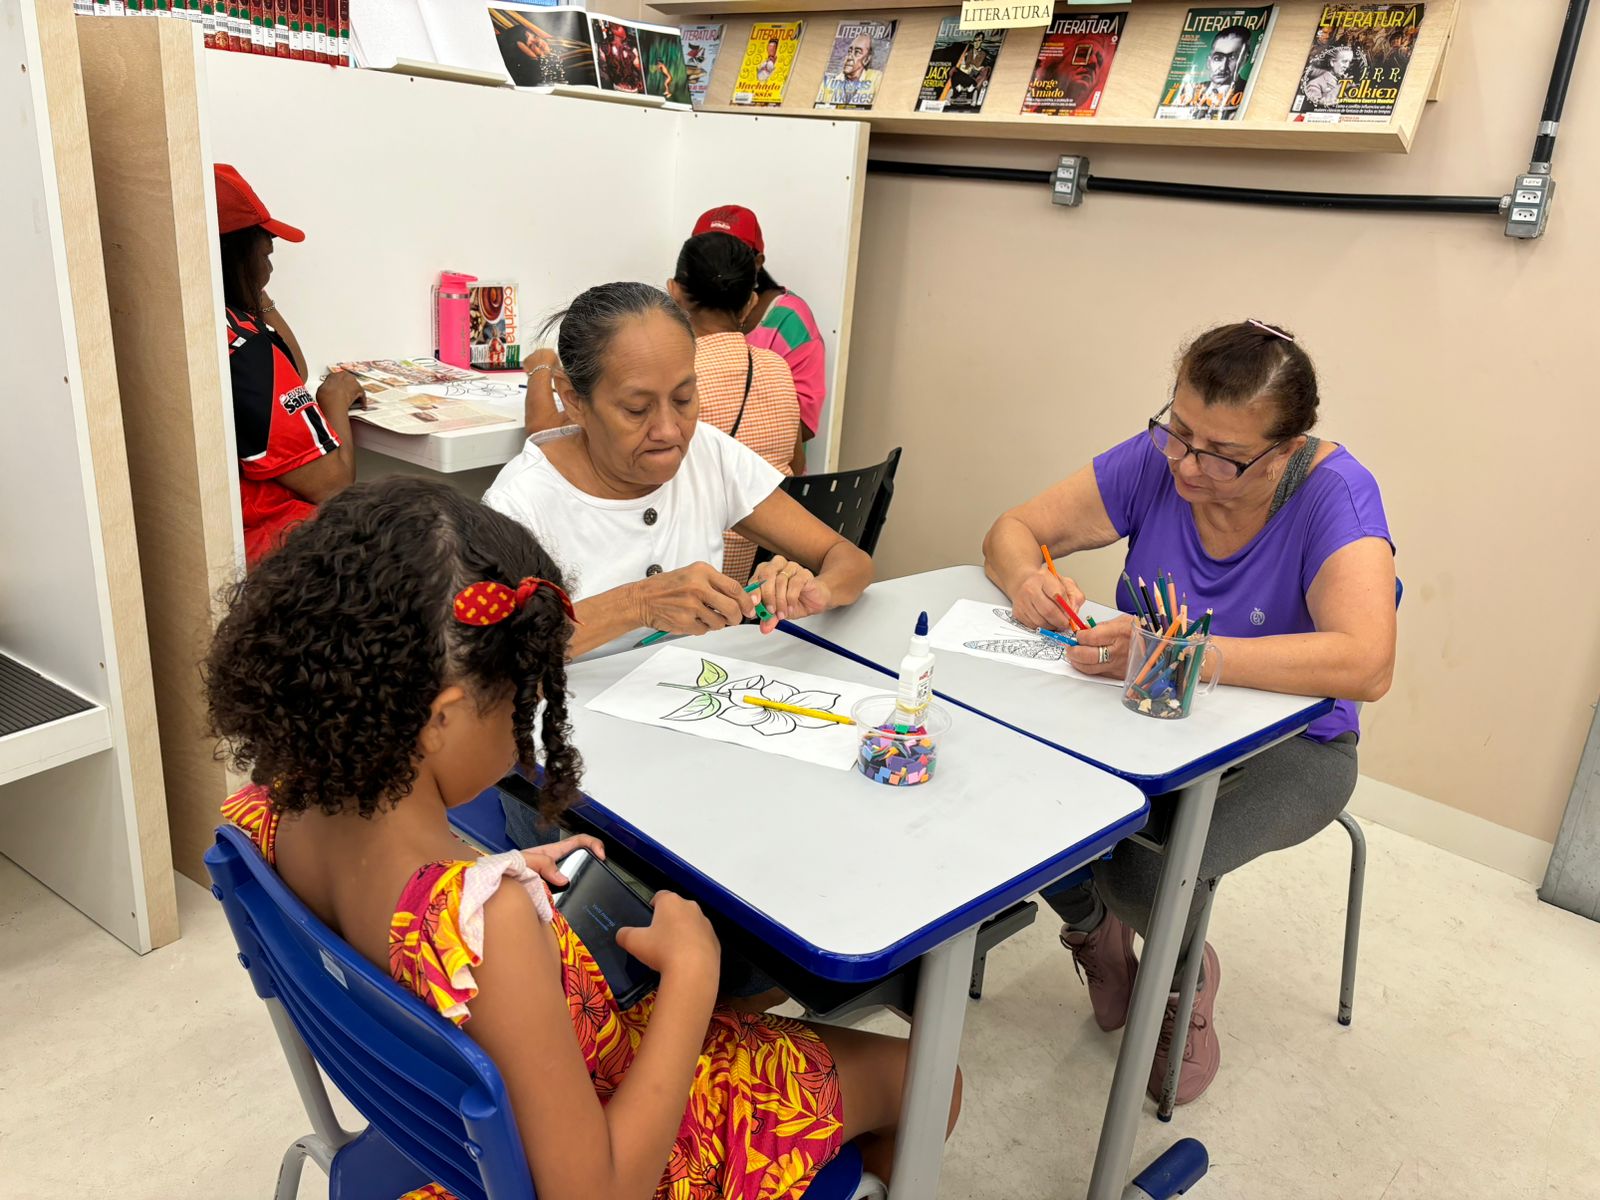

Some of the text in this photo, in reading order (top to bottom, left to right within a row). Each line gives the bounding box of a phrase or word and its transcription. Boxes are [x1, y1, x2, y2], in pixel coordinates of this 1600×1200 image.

[964, 5, 1051, 22] LITERATURA
[1183, 10, 1268, 32] LITERATURA
[1320, 6, 1417, 29] LITERATURA
[750, 23, 801, 41] LITERATURA
[834, 22, 895, 39] LITERATURA
[1045, 15, 1119, 35] LITERATURA
[926, 66, 950, 80] JACK
[1372, 67, 1385, 83] R.
[1388, 67, 1401, 83] R.
[736, 82, 781, 91] Machado
[1030, 79, 1058, 90] Jorge
[1338, 80, 1398, 99] Tolkien
[1029, 89, 1065, 98] Amado
[504, 286, 517, 344] cozinha
